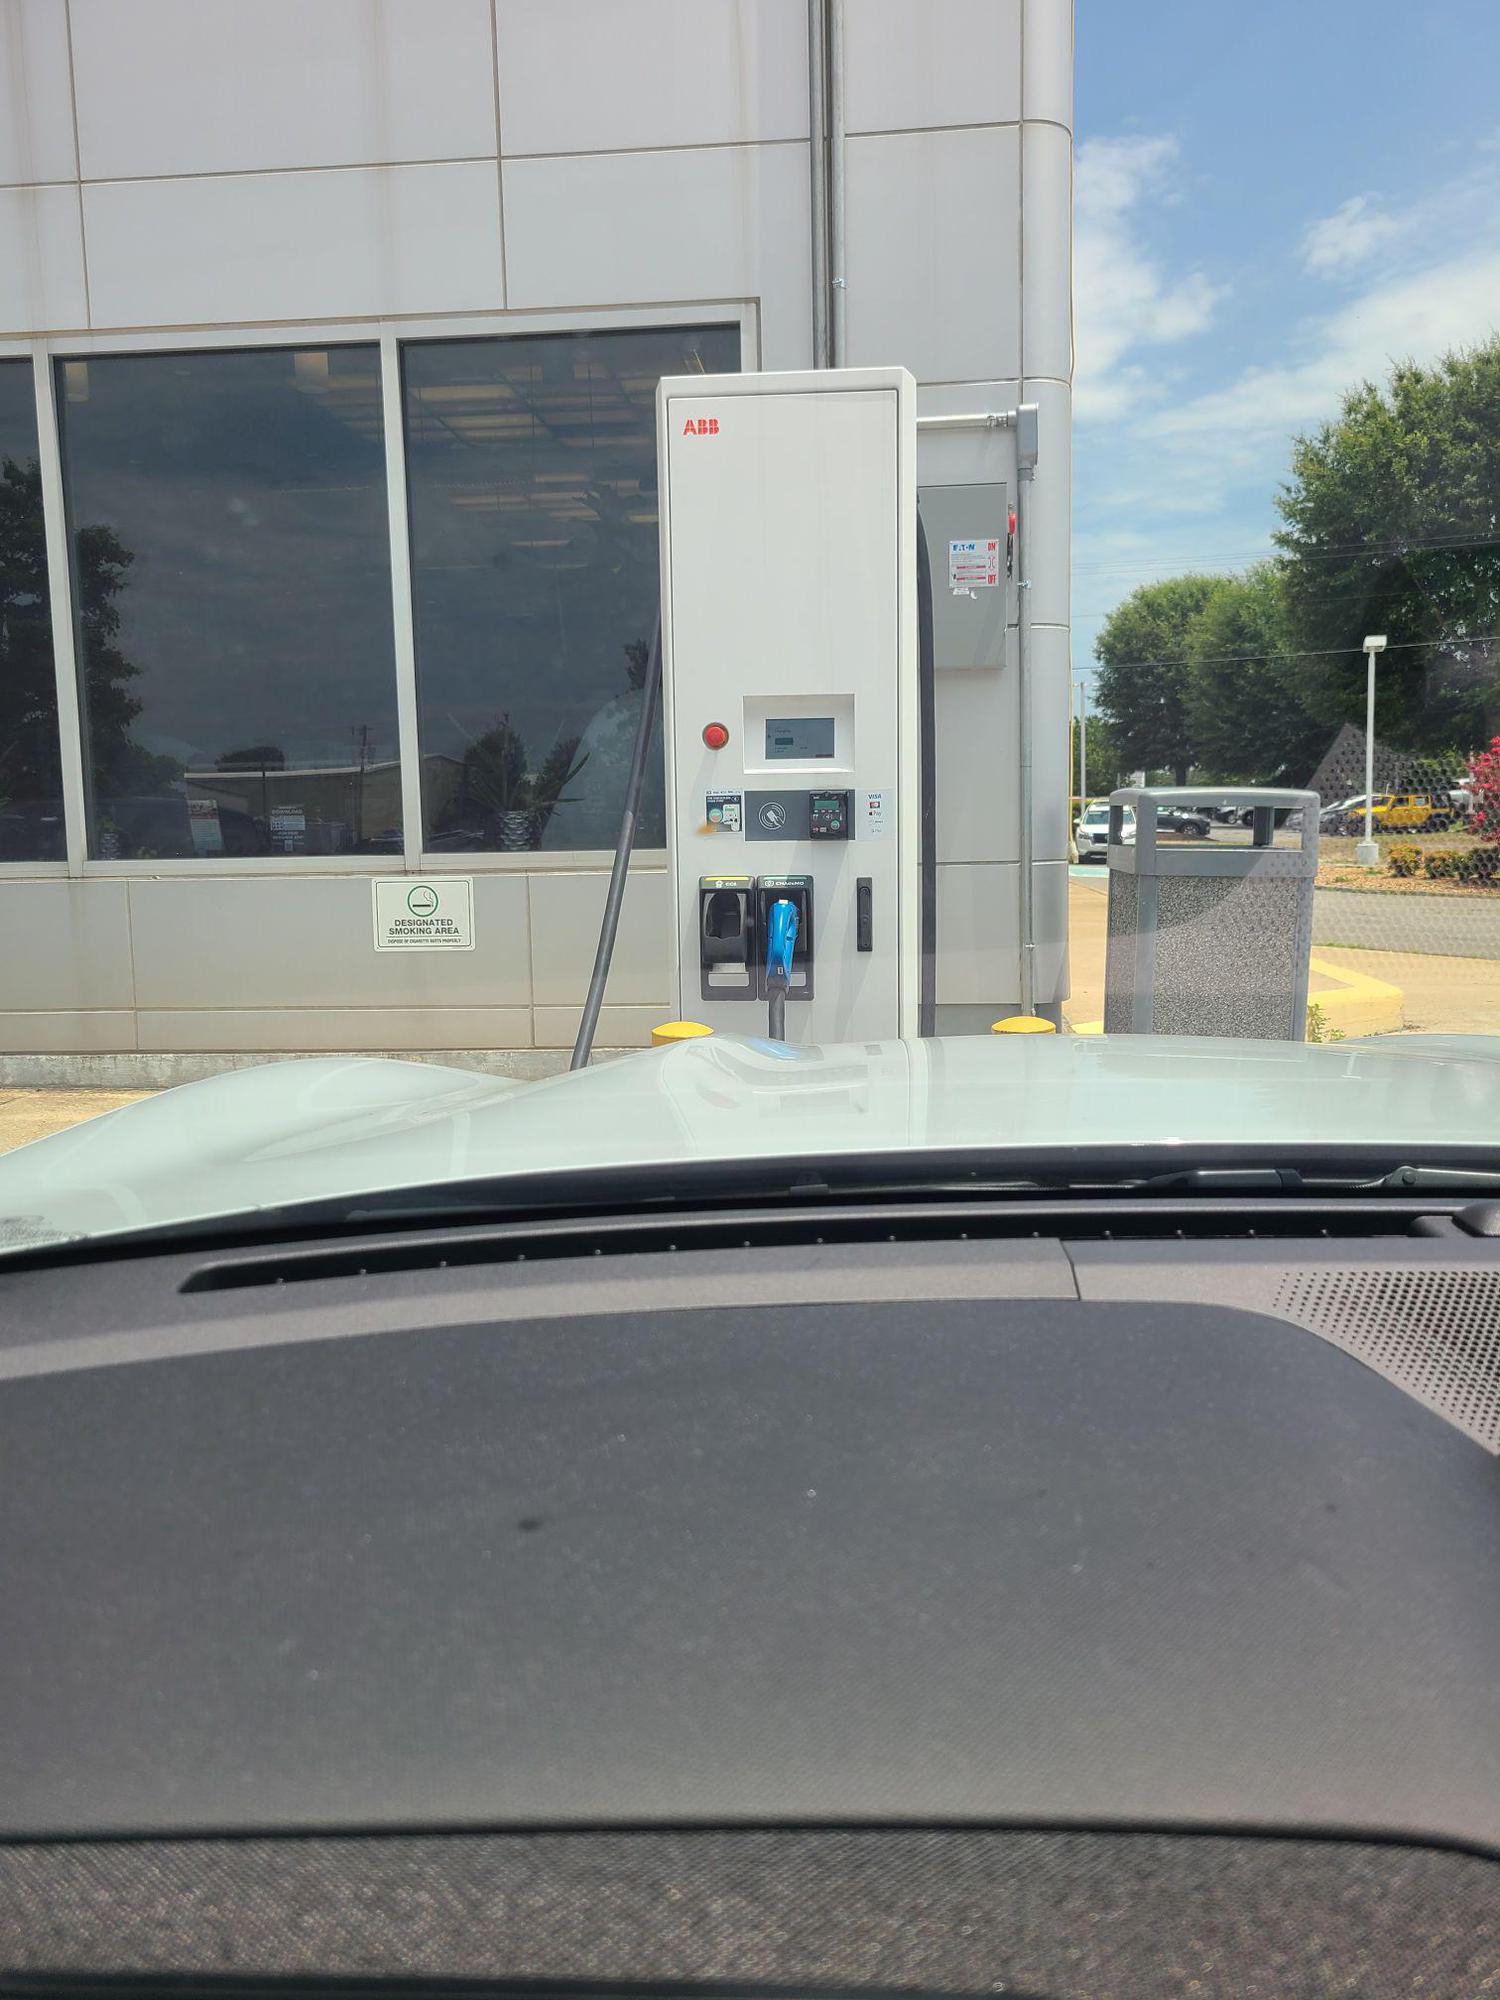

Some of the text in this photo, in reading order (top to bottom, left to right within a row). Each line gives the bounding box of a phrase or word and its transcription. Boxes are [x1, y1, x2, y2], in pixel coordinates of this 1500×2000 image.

[683, 419, 720, 435] ABB
[988, 542, 996, 551] ON
[394, 919, 454, 927] DESIGNATED
[389, 927, 460, 935] SMOKING AREA
